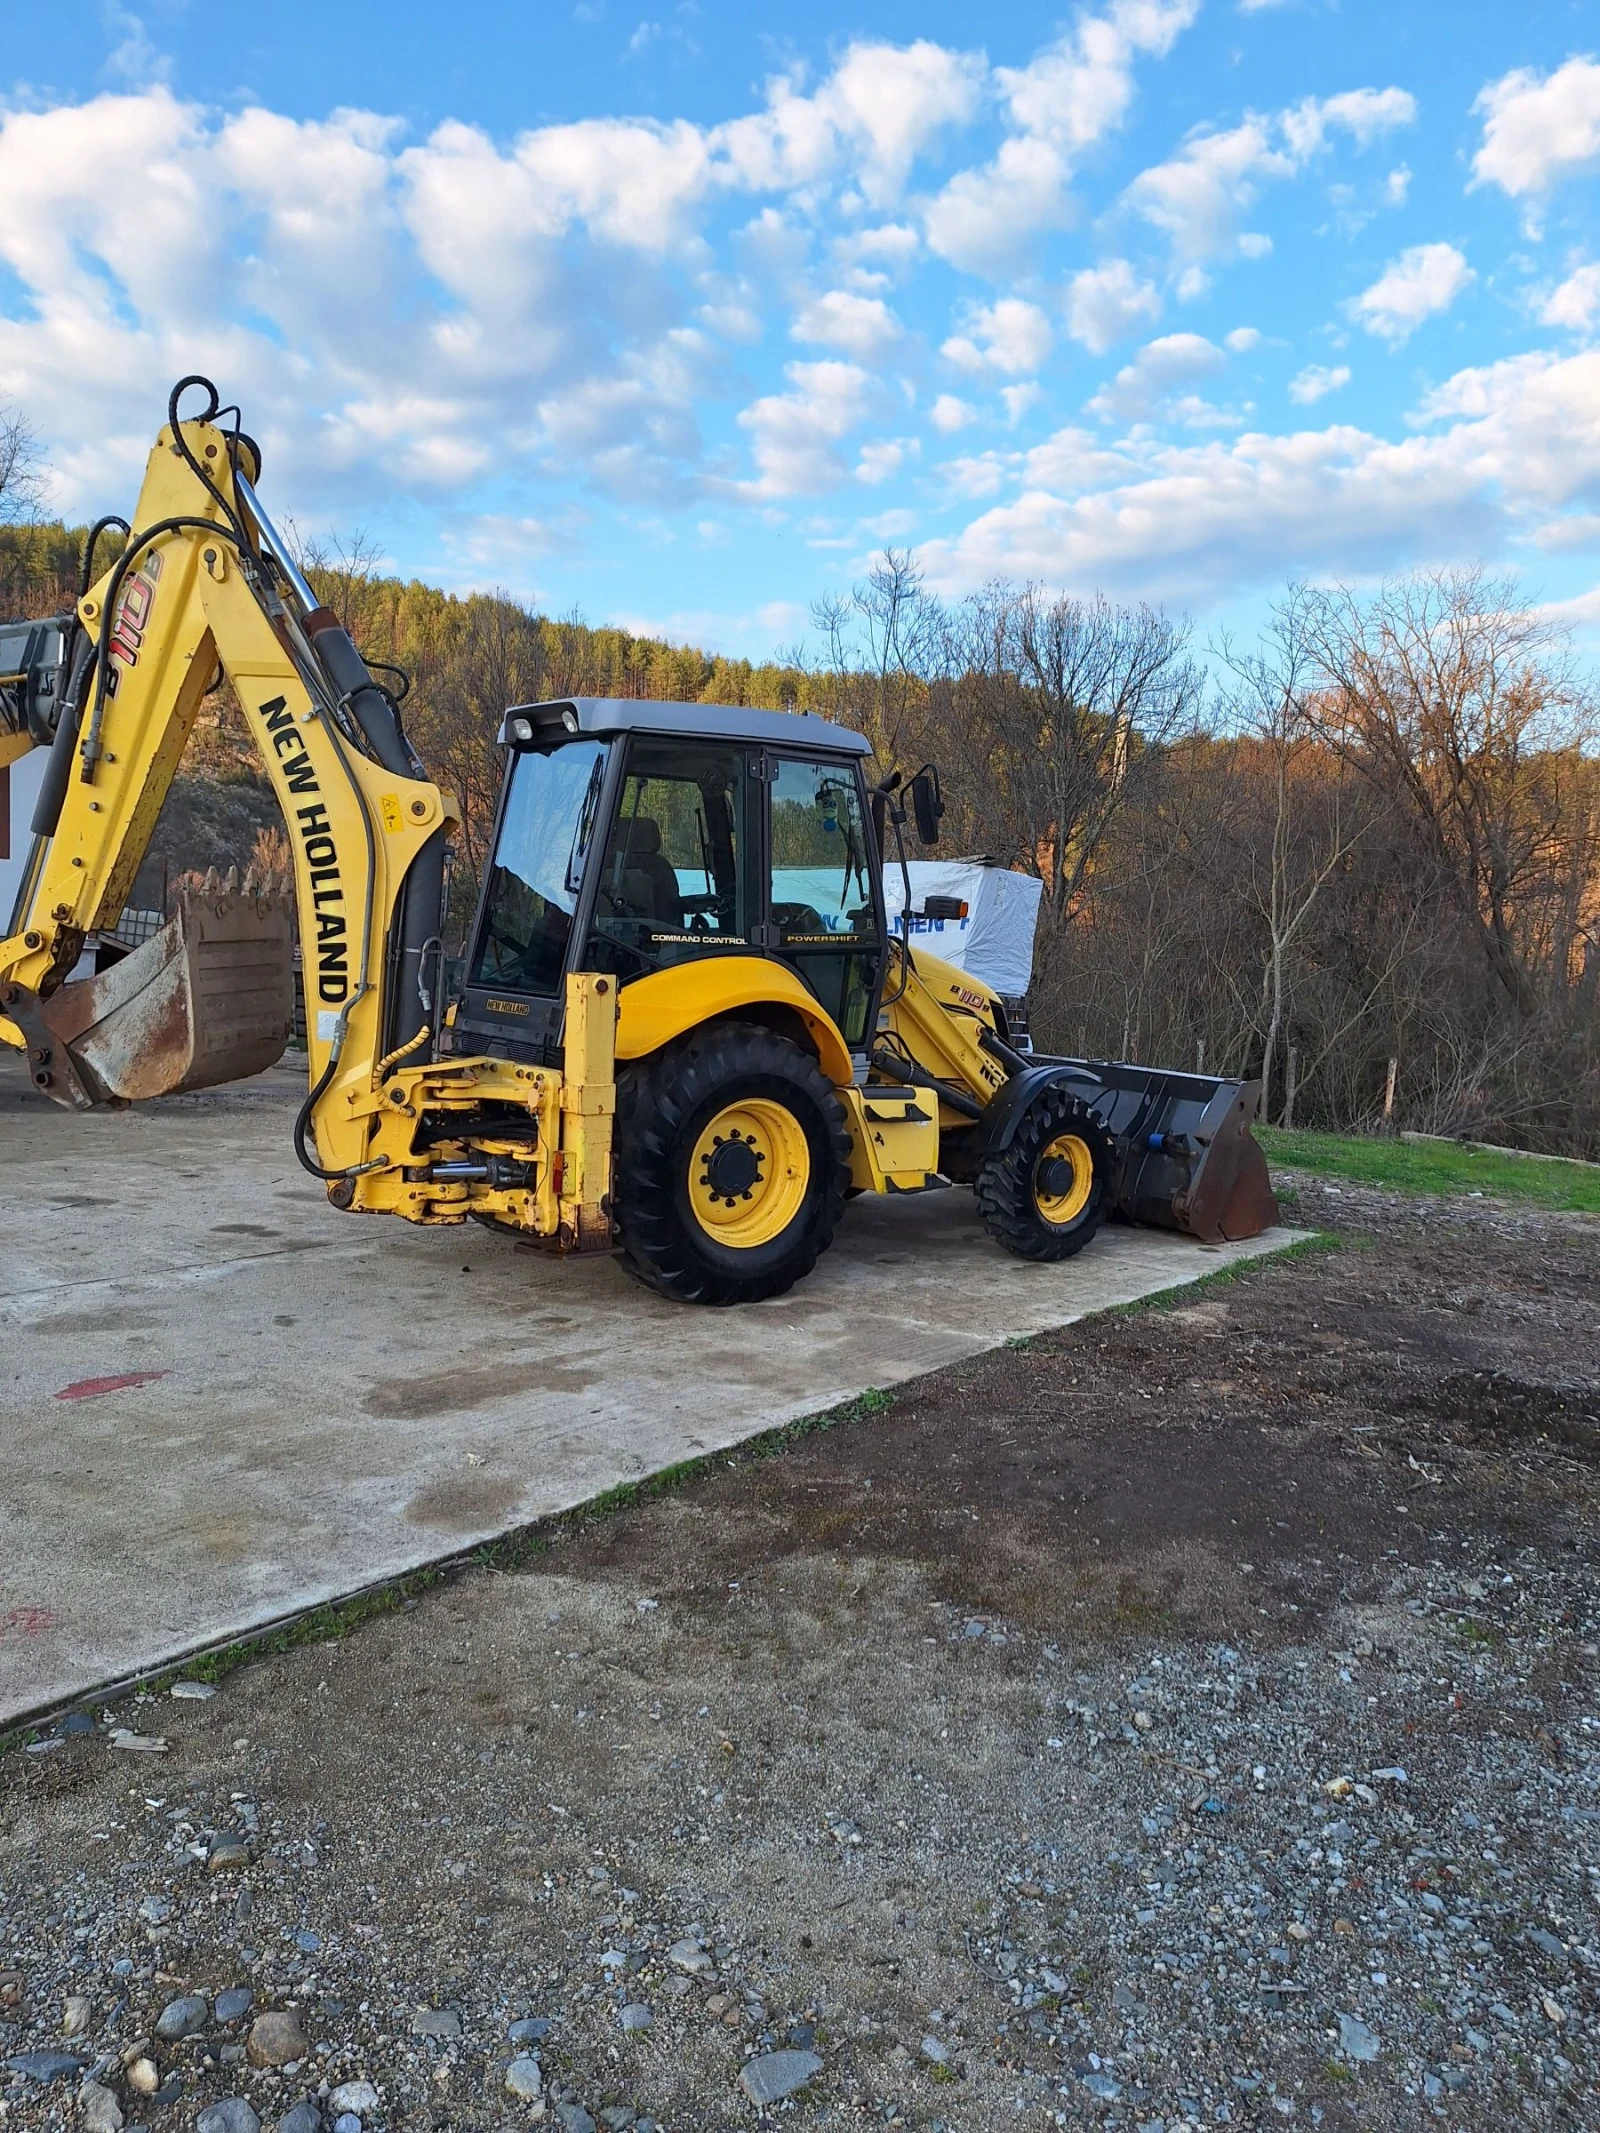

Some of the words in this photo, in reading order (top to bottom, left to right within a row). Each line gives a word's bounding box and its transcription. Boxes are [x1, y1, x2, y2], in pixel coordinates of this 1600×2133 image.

[259, 695, 321, 793] NEW
[296, 803, 348, 1003] HOLLAND
[651, 934, 701, 943] COMMAND
[702, 936, 748, 945] CONTROL
[487, 1000, 501, 1011] NEW
[500, 1002, 528, 1014] HOLLAND
